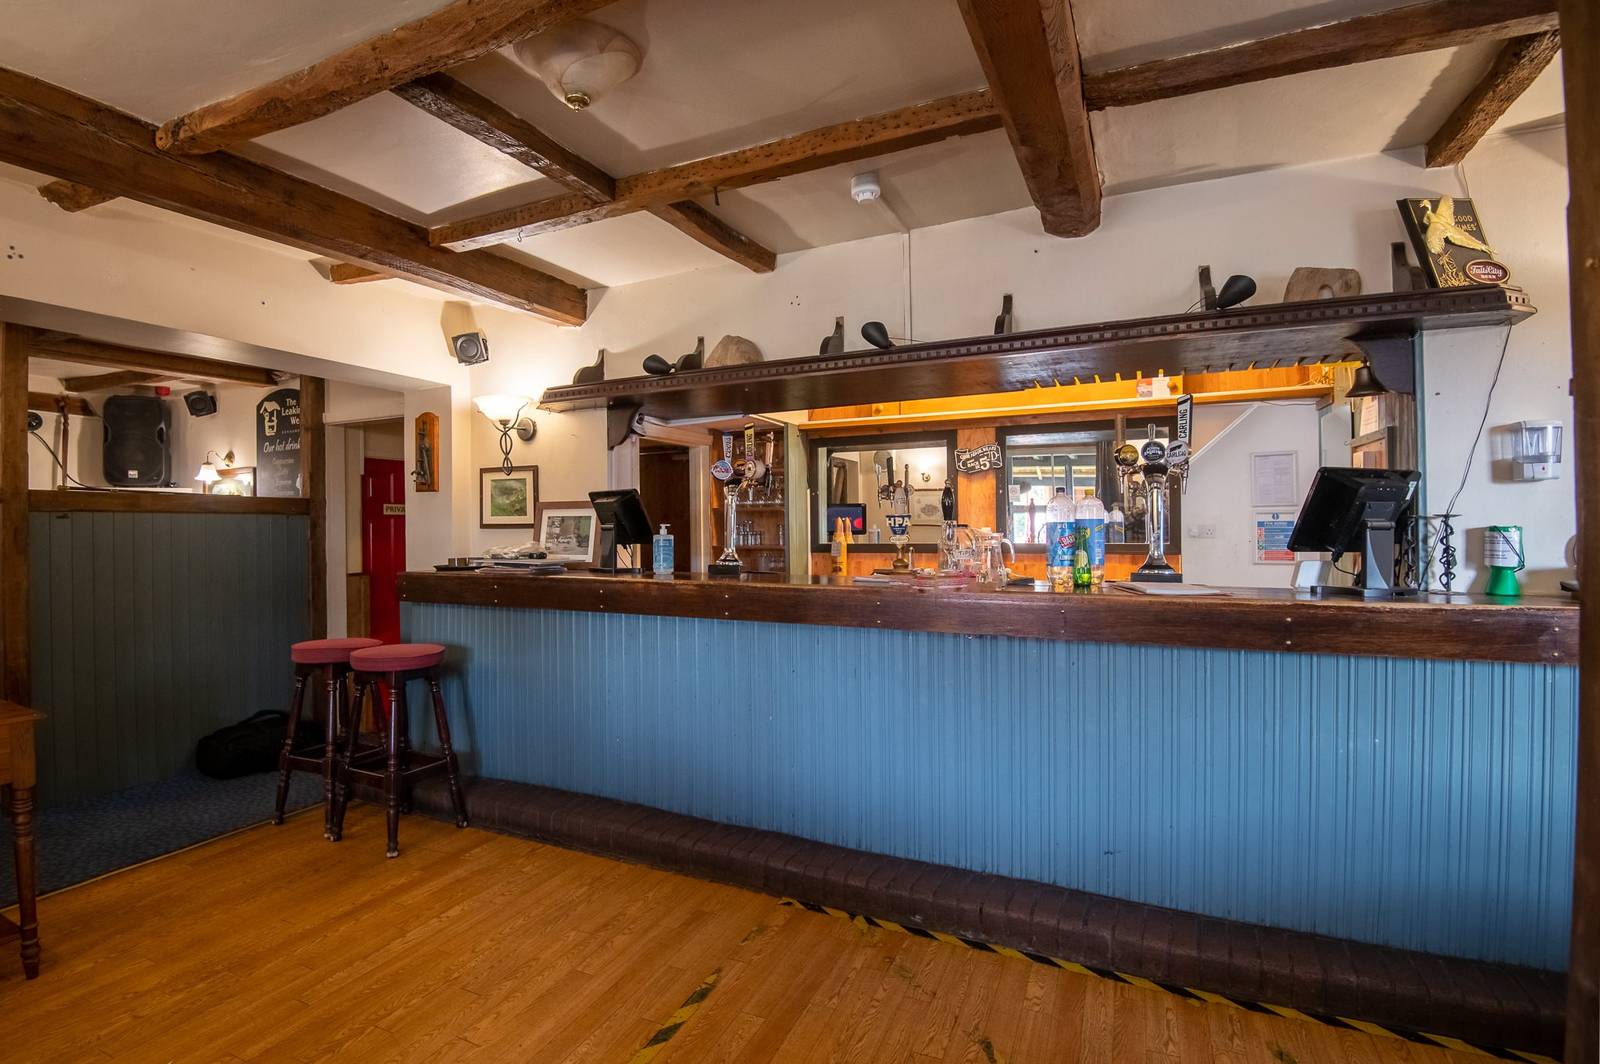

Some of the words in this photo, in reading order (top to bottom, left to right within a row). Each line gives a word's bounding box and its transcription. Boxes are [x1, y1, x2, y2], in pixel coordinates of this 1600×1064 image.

[286, 398, 297, 406] The
[290, 416, 300, 425] We
[1178, 408, 1188, 439] CARLING
[1167, 449, 1187, 459] CARLING
[385, 505, 406, 513] PRIVA
[887, 516, 911, 527] HPA
